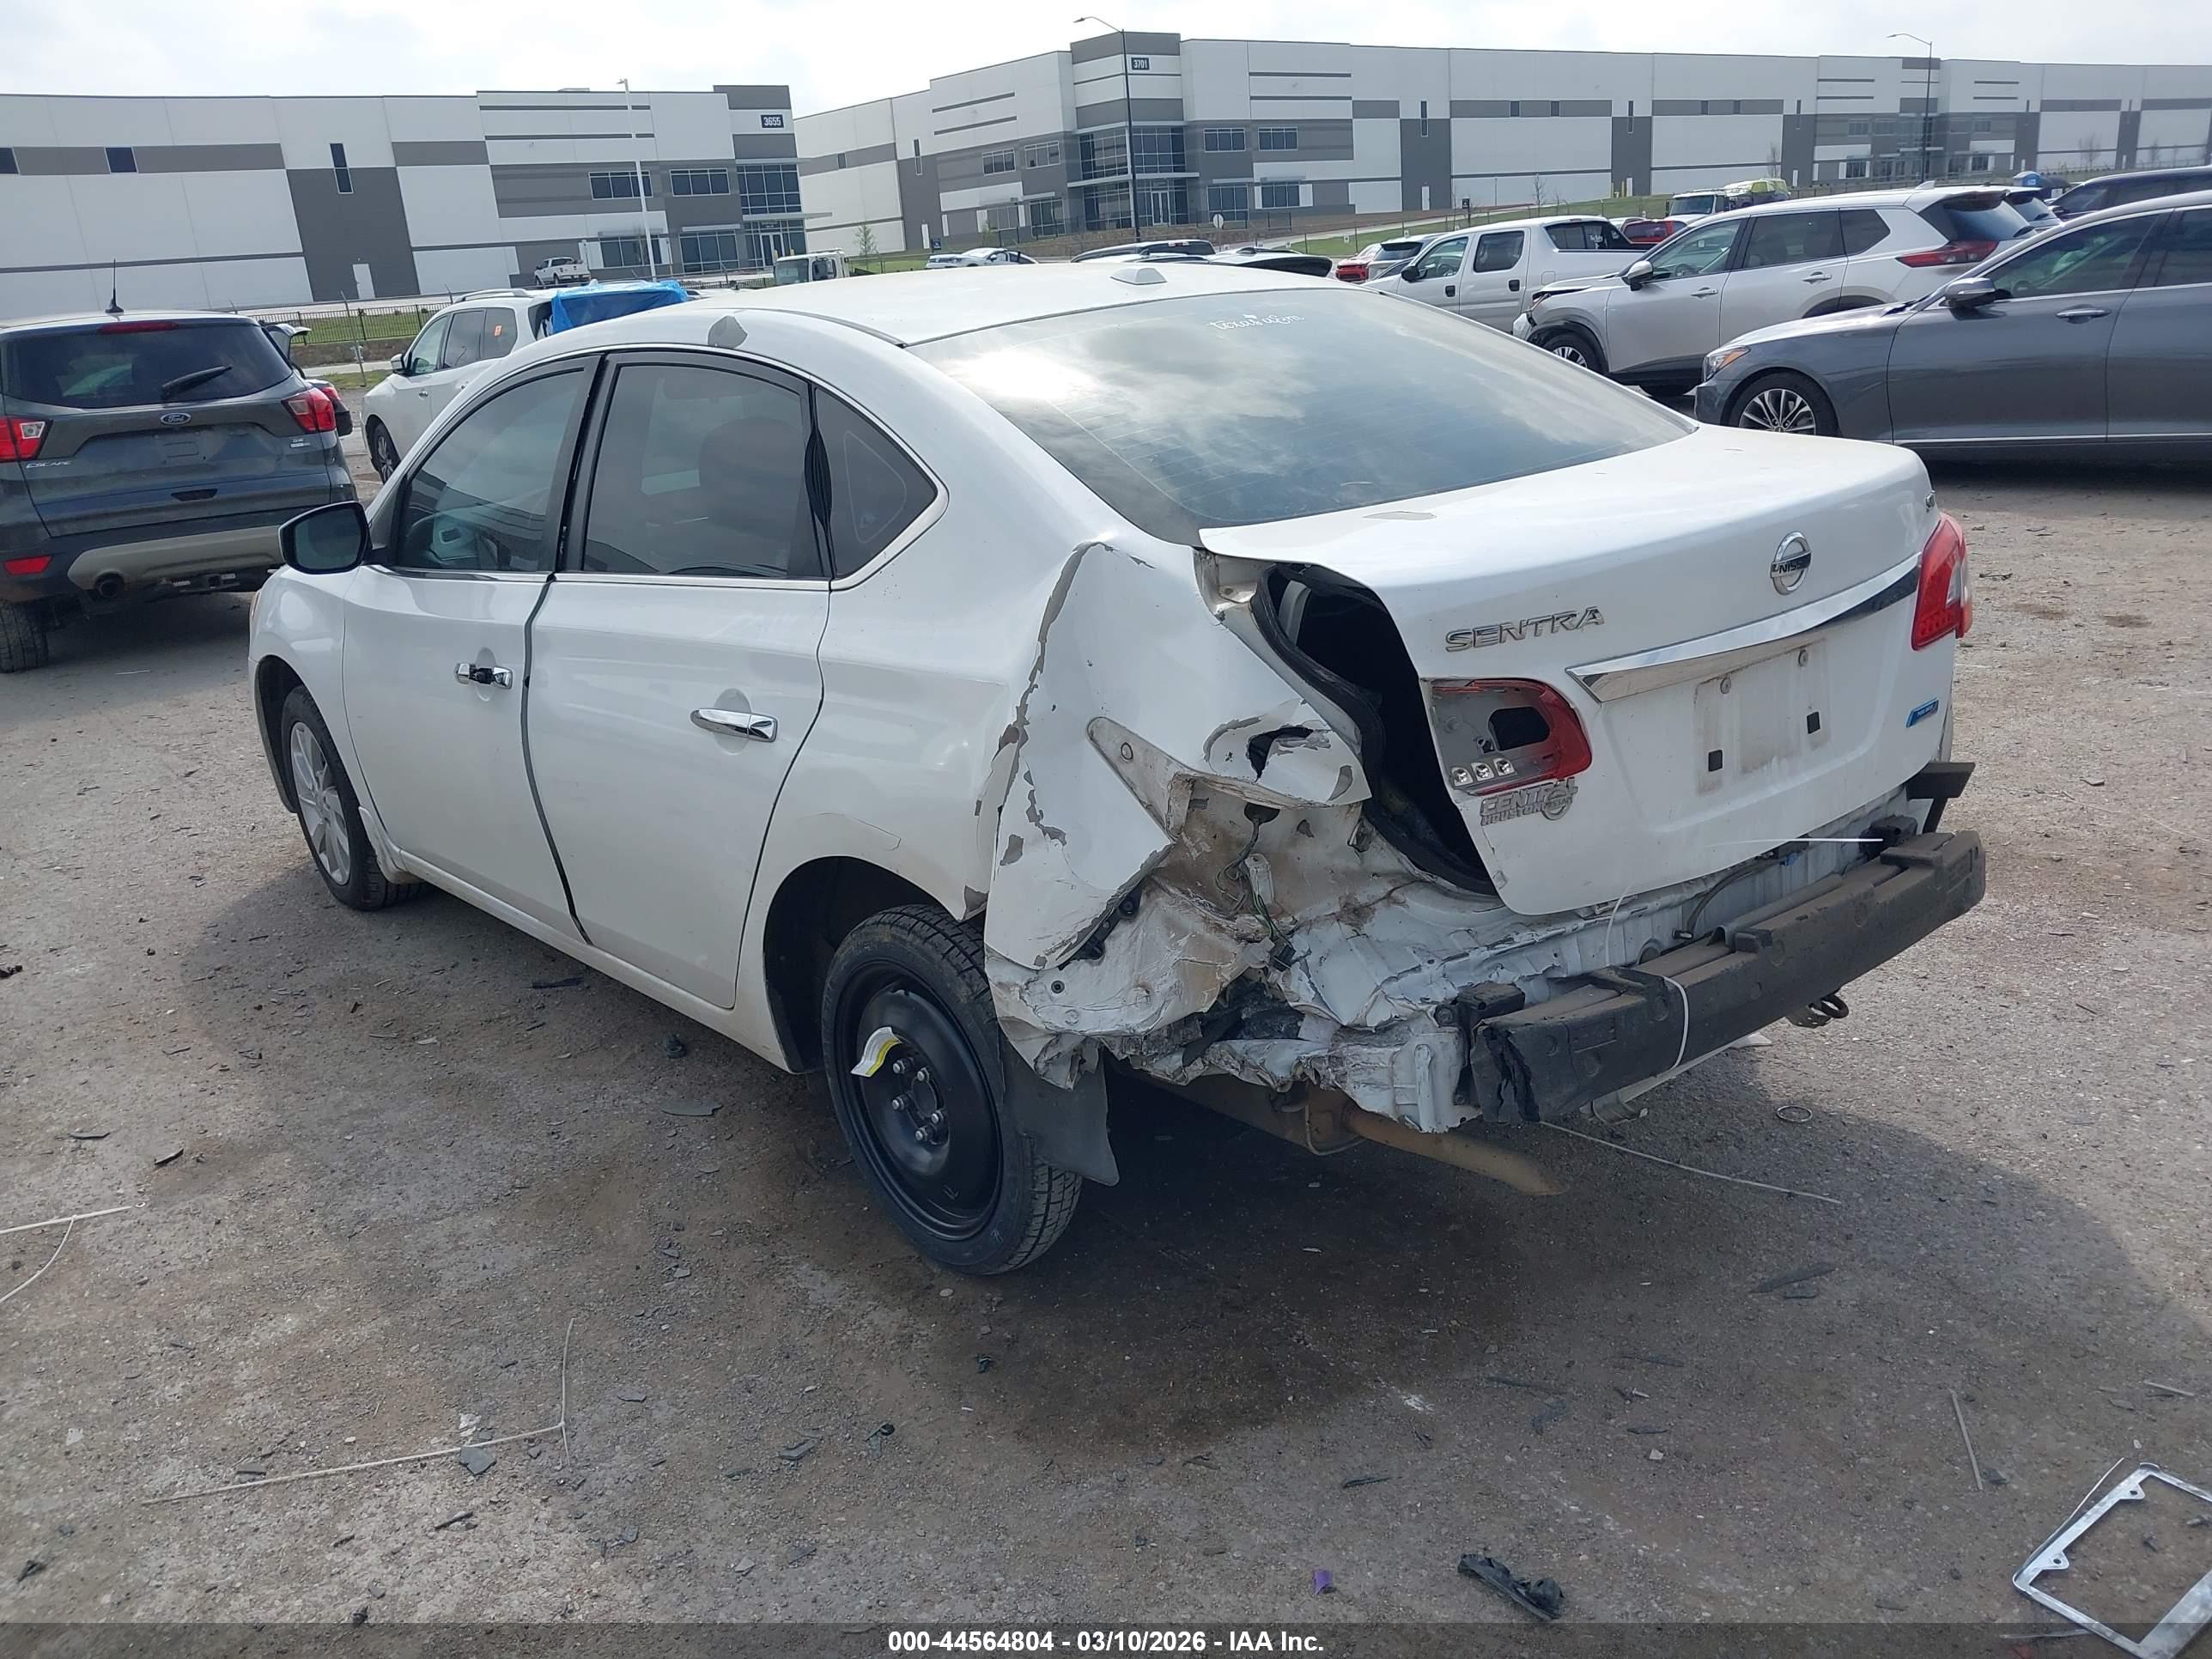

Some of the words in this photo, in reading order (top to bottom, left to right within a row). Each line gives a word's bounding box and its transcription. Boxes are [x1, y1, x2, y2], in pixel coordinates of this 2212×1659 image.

[1133, 59, 1148, 69] 3701
[763, 116, 781, 126] 3655
[26, 460, 72, 469] ESCAPE
[1445, 605, 1605, 653] SENTRA
[1480, 776, 1579, 816] CENTRAL
[1480, 802, 1546, 826] HOUSTON
